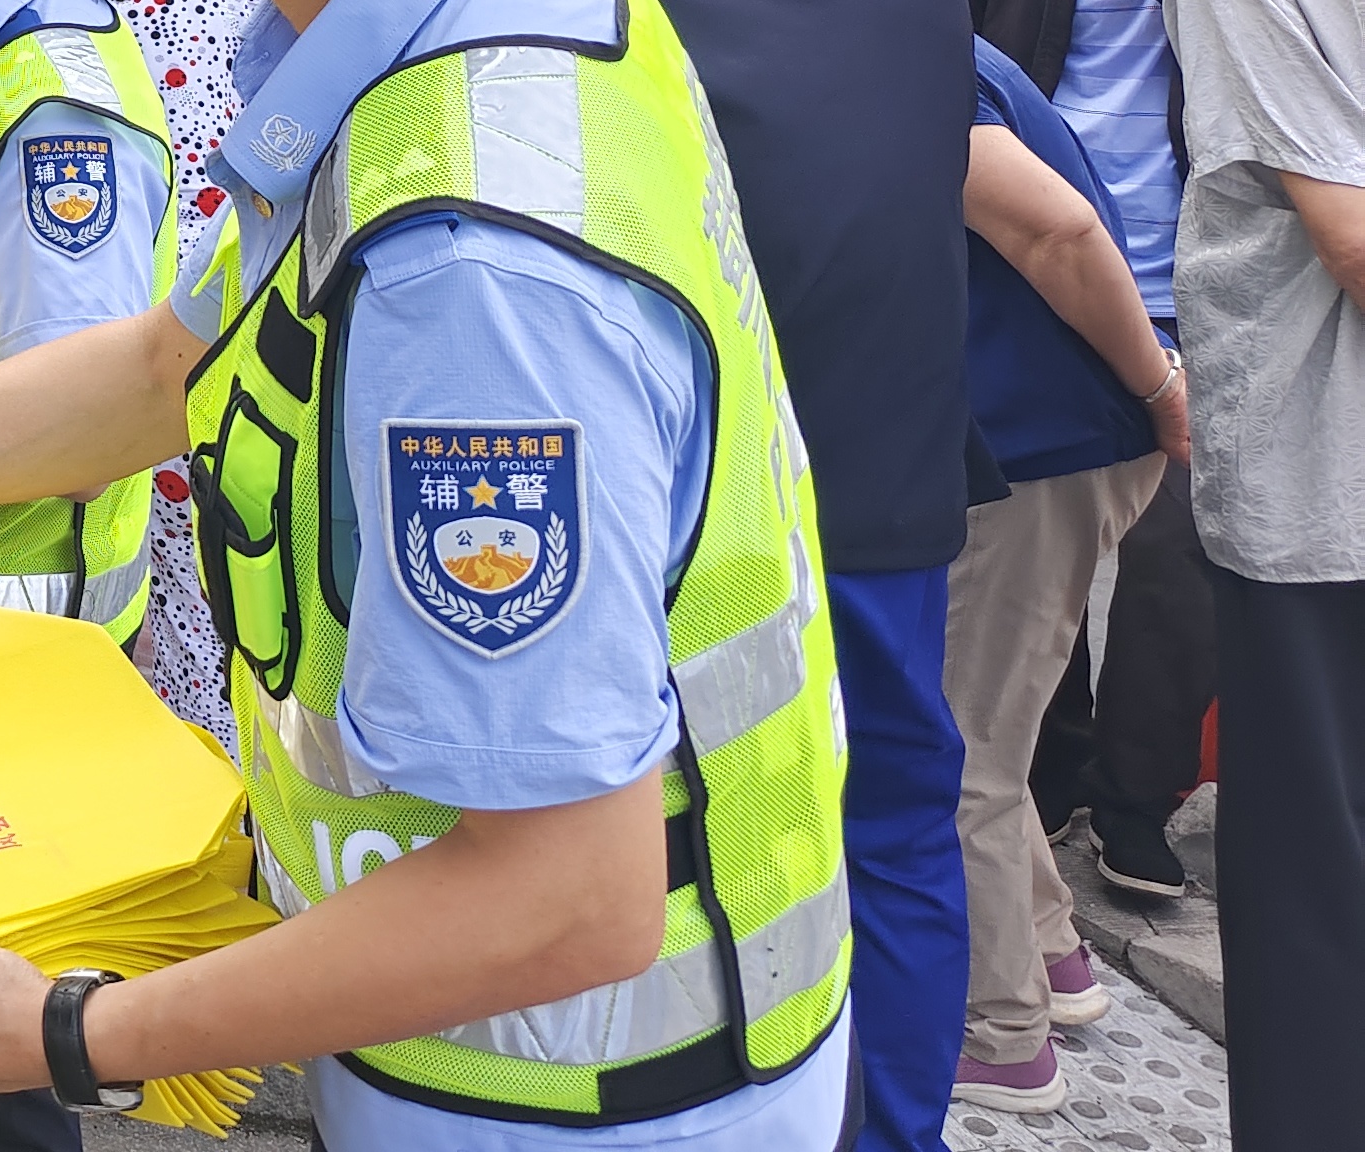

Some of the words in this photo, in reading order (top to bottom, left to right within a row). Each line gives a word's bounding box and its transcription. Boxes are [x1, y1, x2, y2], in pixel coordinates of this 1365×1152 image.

[28, 140, 109, 155] 中华人民共和国
[400, 435, 564, 458] 中华人民共和国
[410, 460, 491, 472] AUXILIARY
[499, 459, 556, 472] POLICE
